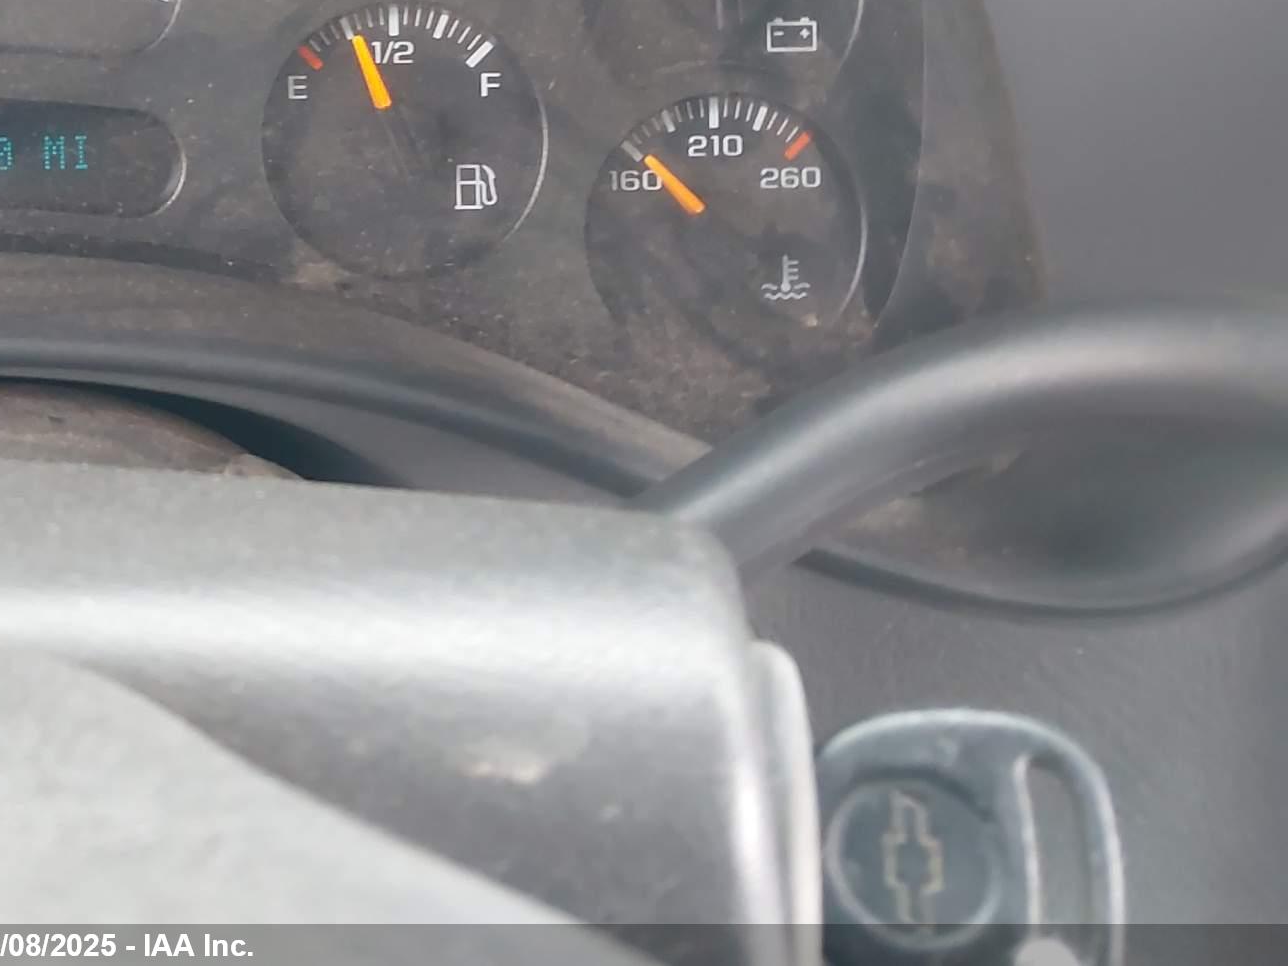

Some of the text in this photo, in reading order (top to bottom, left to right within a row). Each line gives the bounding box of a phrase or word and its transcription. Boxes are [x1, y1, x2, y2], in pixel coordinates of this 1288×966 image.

[372, 40, 414, 65] 1/2
[288, 75, 308, 100] E
[480, 72, 501, 97] F
[43, 135, 89, 171] MI
[687, 135, 743, 157] 210
[610, 169, 663, 191] 160
[760, 167, 821, 189] 260
